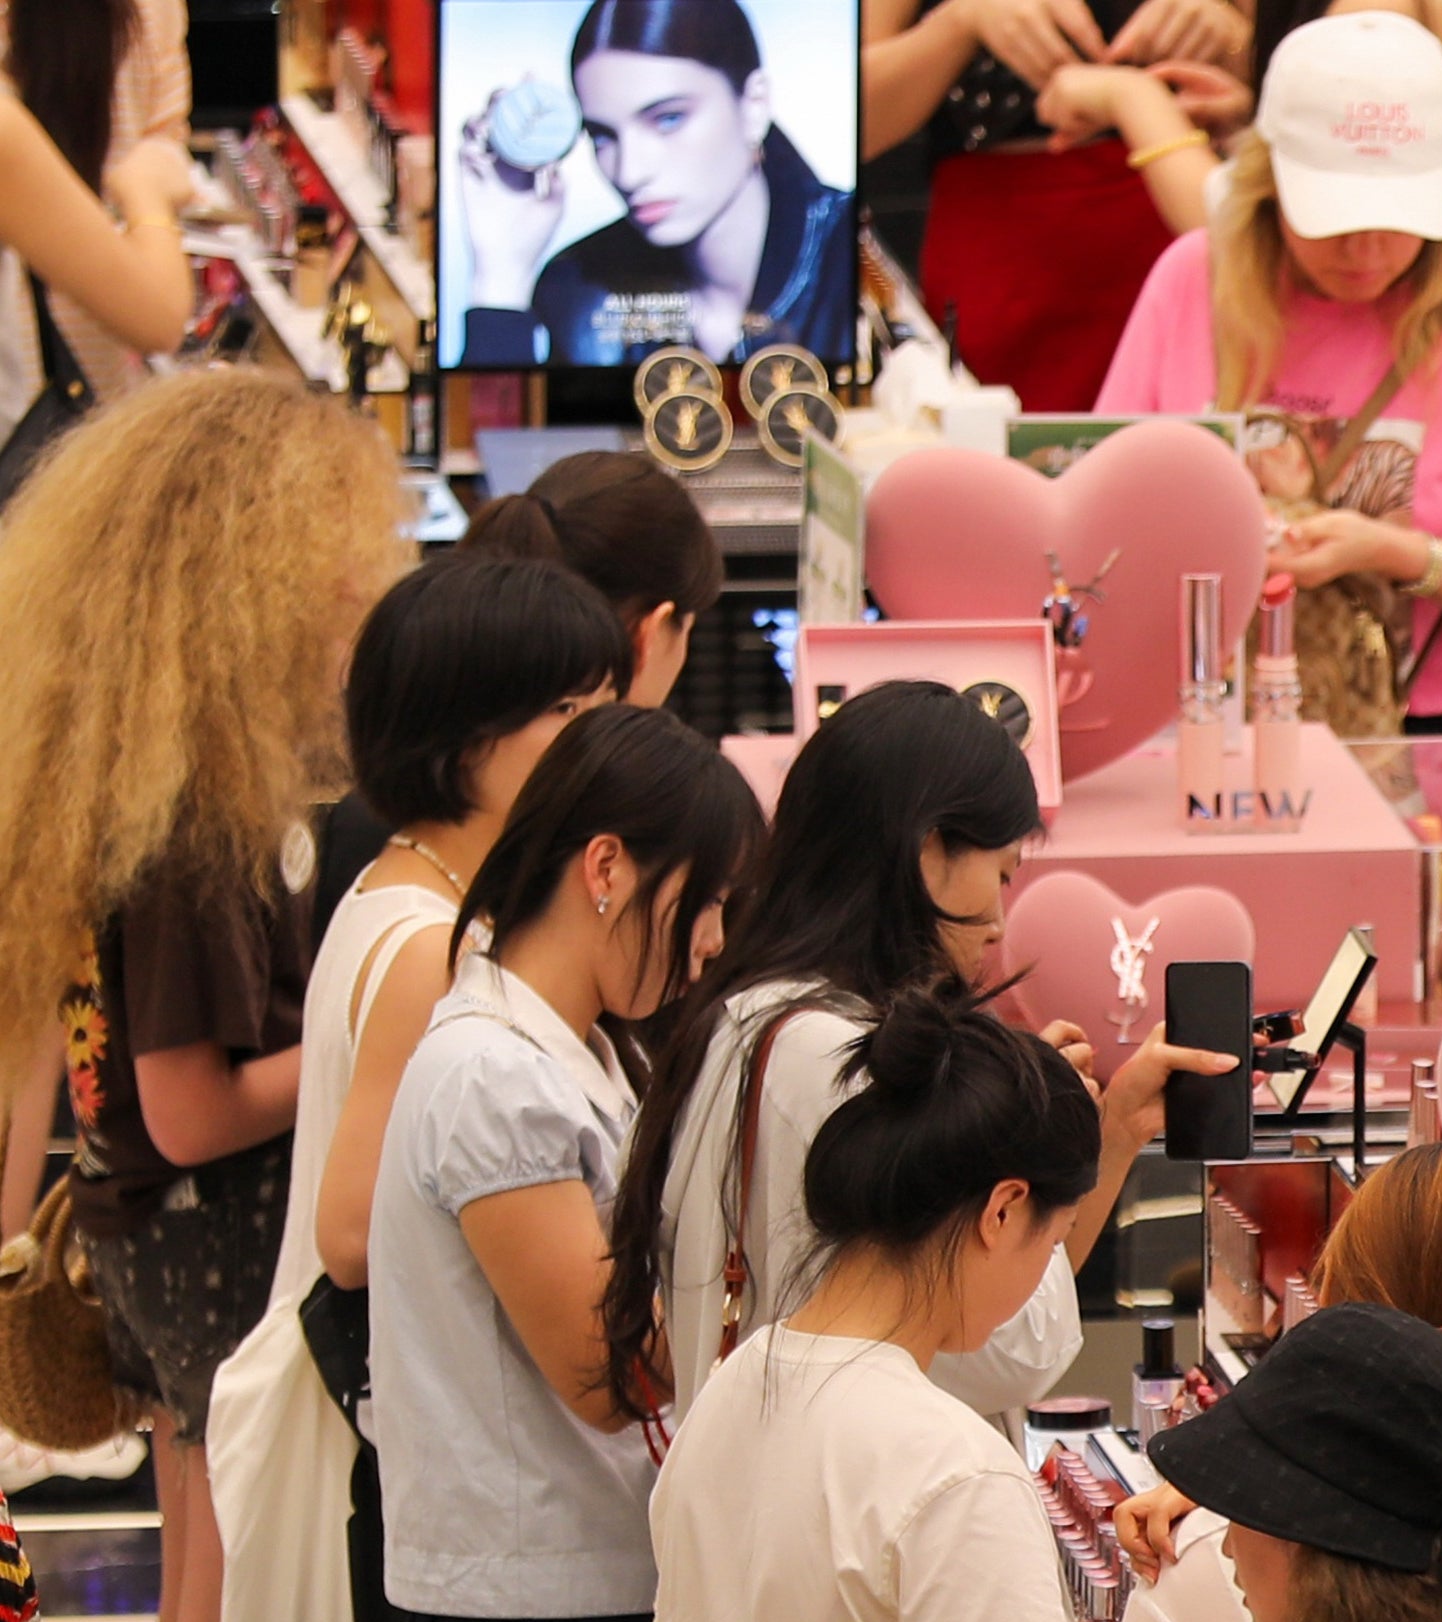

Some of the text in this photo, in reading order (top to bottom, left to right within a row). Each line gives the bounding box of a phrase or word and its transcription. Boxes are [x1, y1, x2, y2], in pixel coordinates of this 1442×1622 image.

[1344, 101, 1408, 121] LOUIS
[1330, 123, 1424, 144] VUITTON
[1186, 787, 1315, 820] NEW
